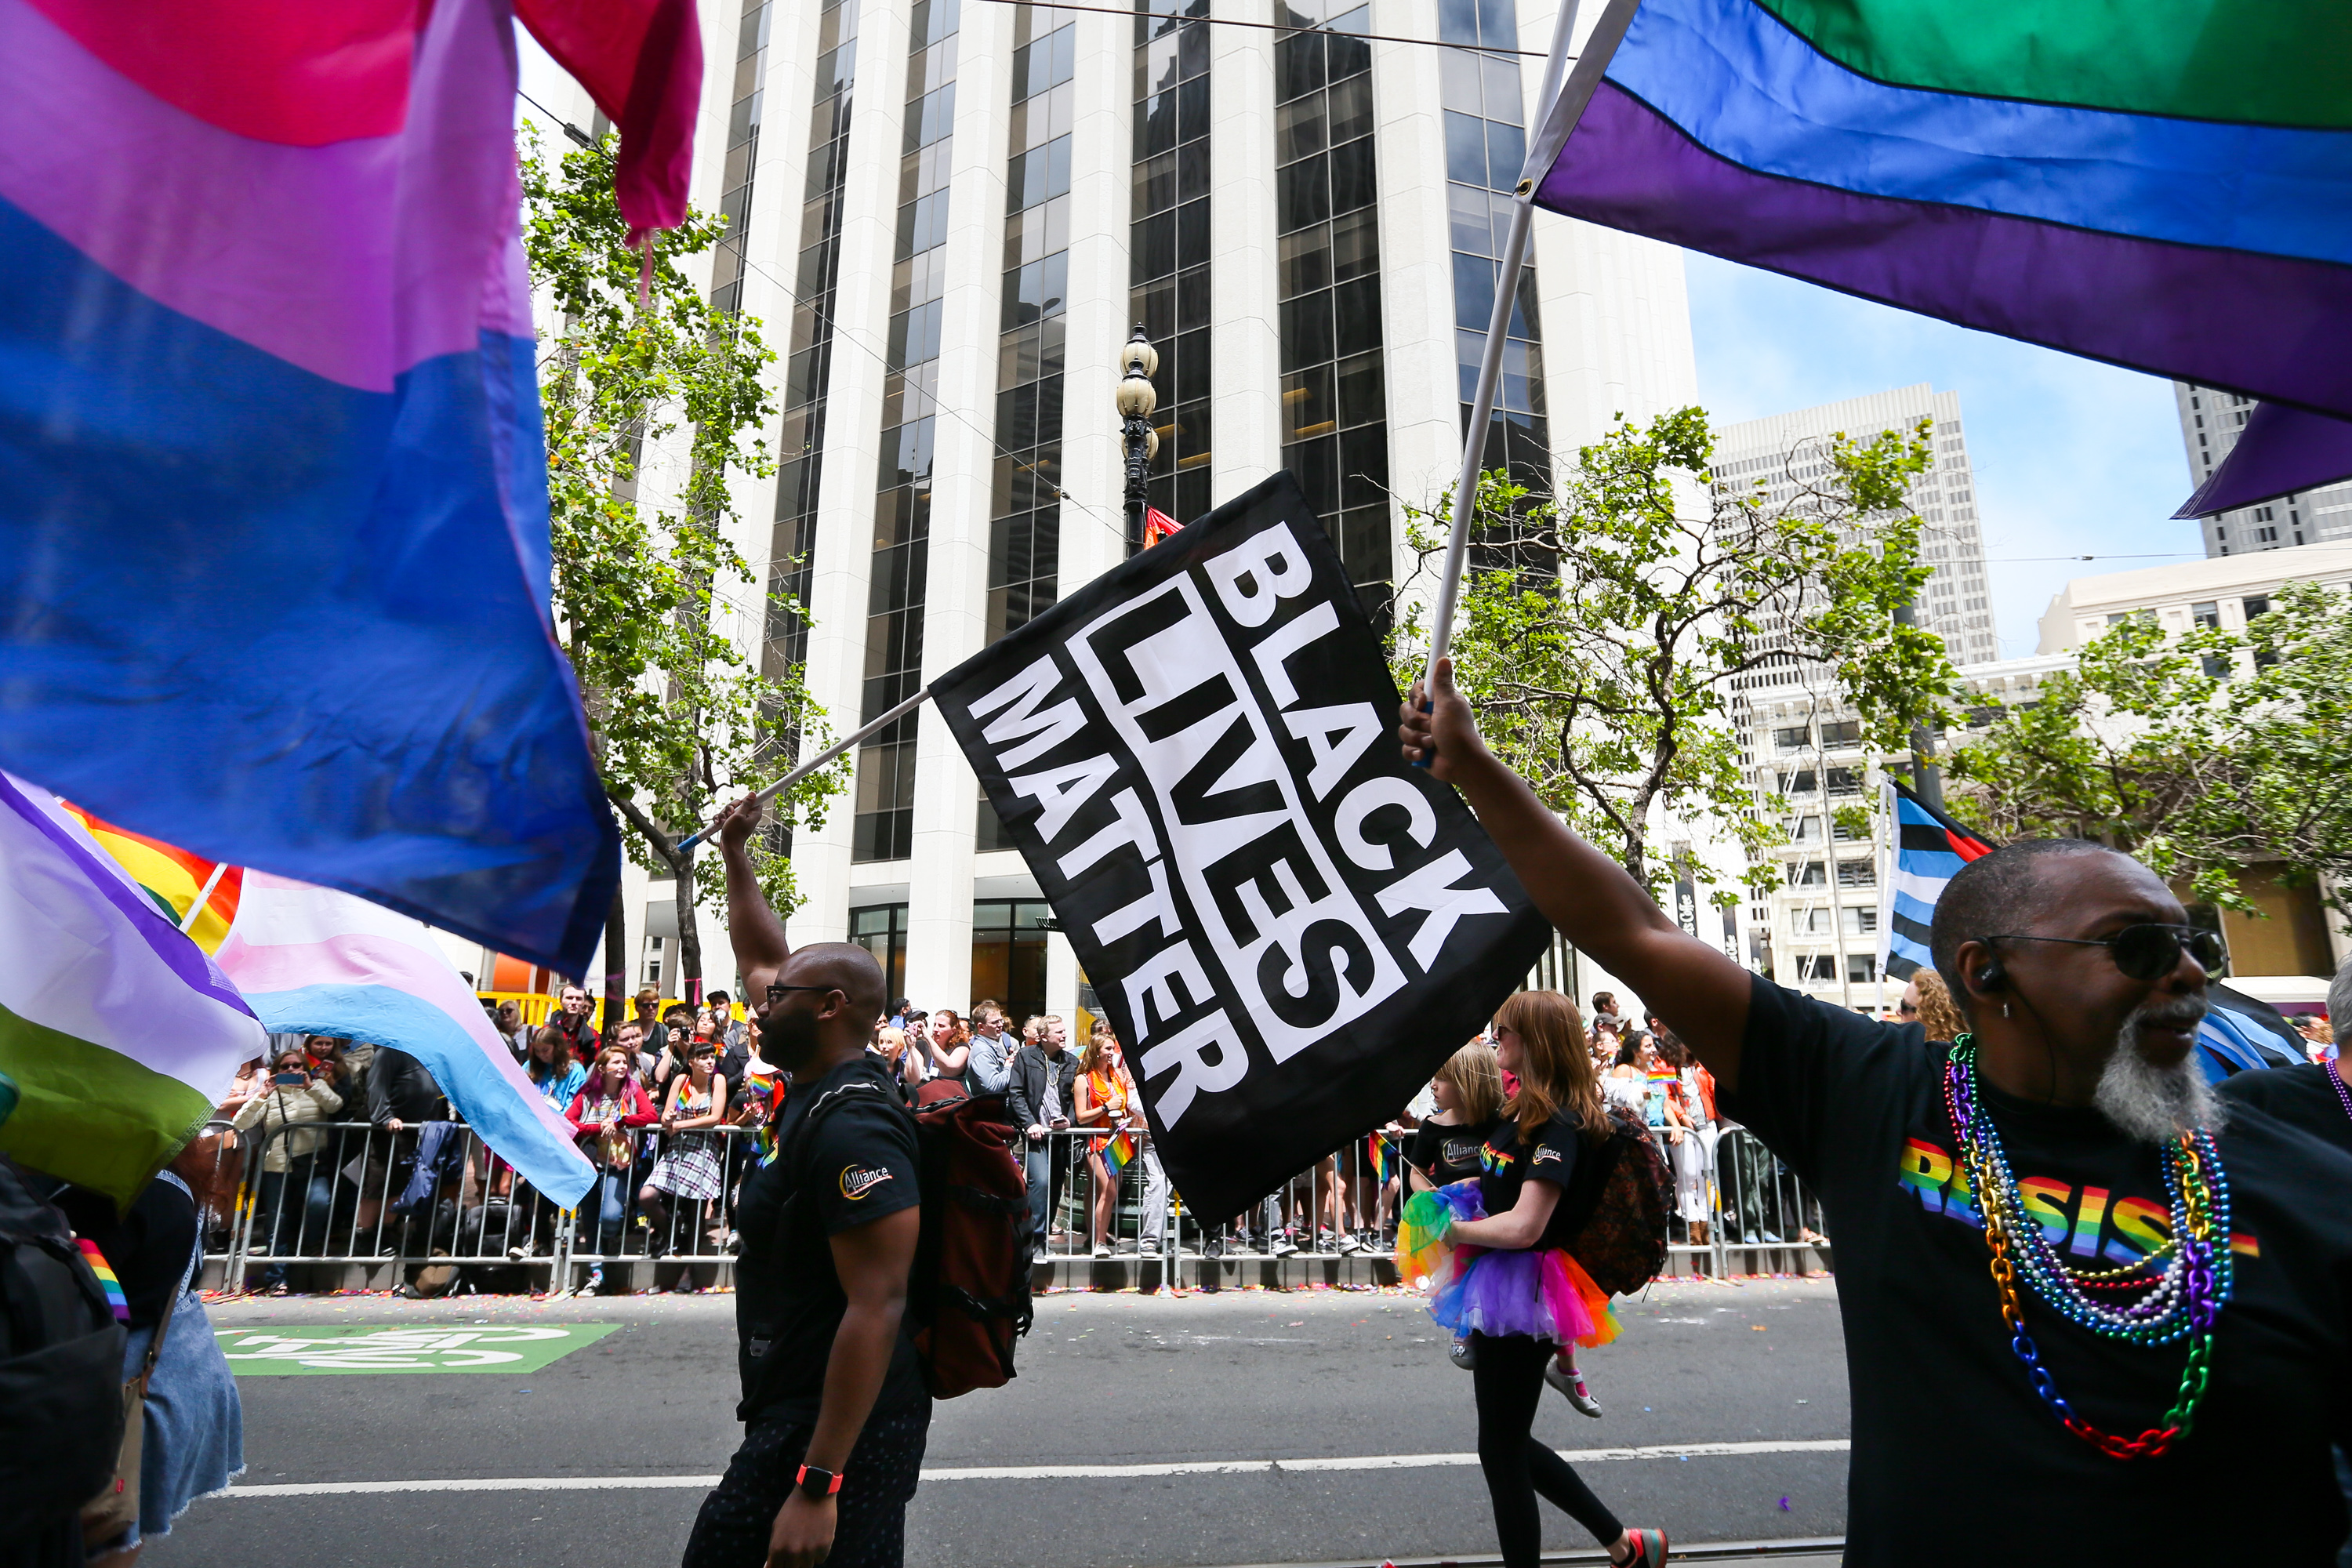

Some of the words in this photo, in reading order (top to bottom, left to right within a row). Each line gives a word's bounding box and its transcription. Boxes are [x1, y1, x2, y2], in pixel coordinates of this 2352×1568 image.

[967, 653, 1249, 1131] MATTER
[1086, 593, 1376, 1028] LIVES
[1203, 520, 1510, 974] BLACK
[844, 1167, 889, 1194] Alliance
[1898, 1137, 2260, 1294] RESIS
